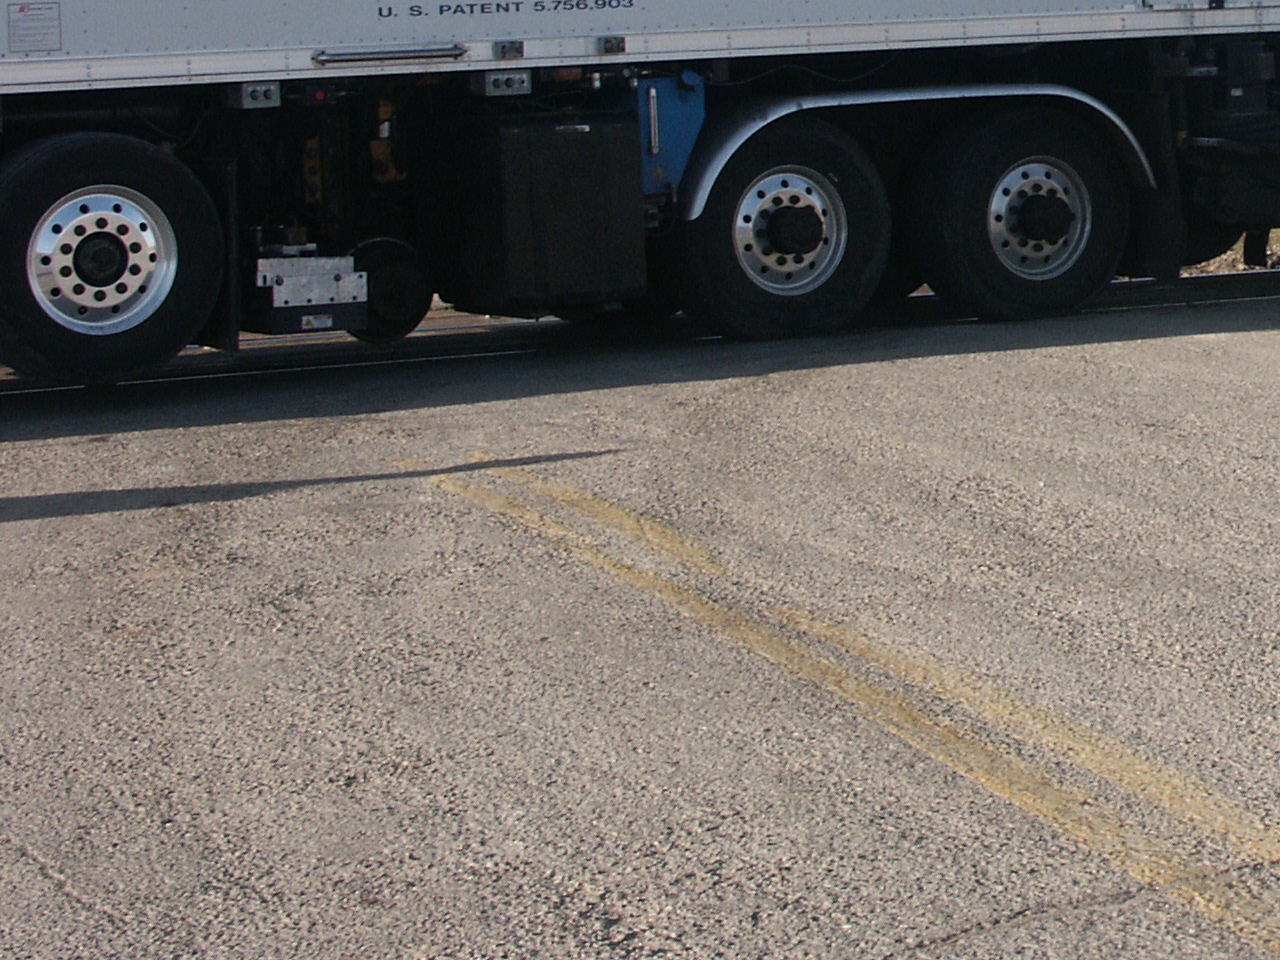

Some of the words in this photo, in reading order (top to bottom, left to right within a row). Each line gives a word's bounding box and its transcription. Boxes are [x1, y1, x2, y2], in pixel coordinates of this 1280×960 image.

[378, 6, 398, 18] U.
[409, 5, 429, 17] S.
[438, 1, 524, 16] PATENT
